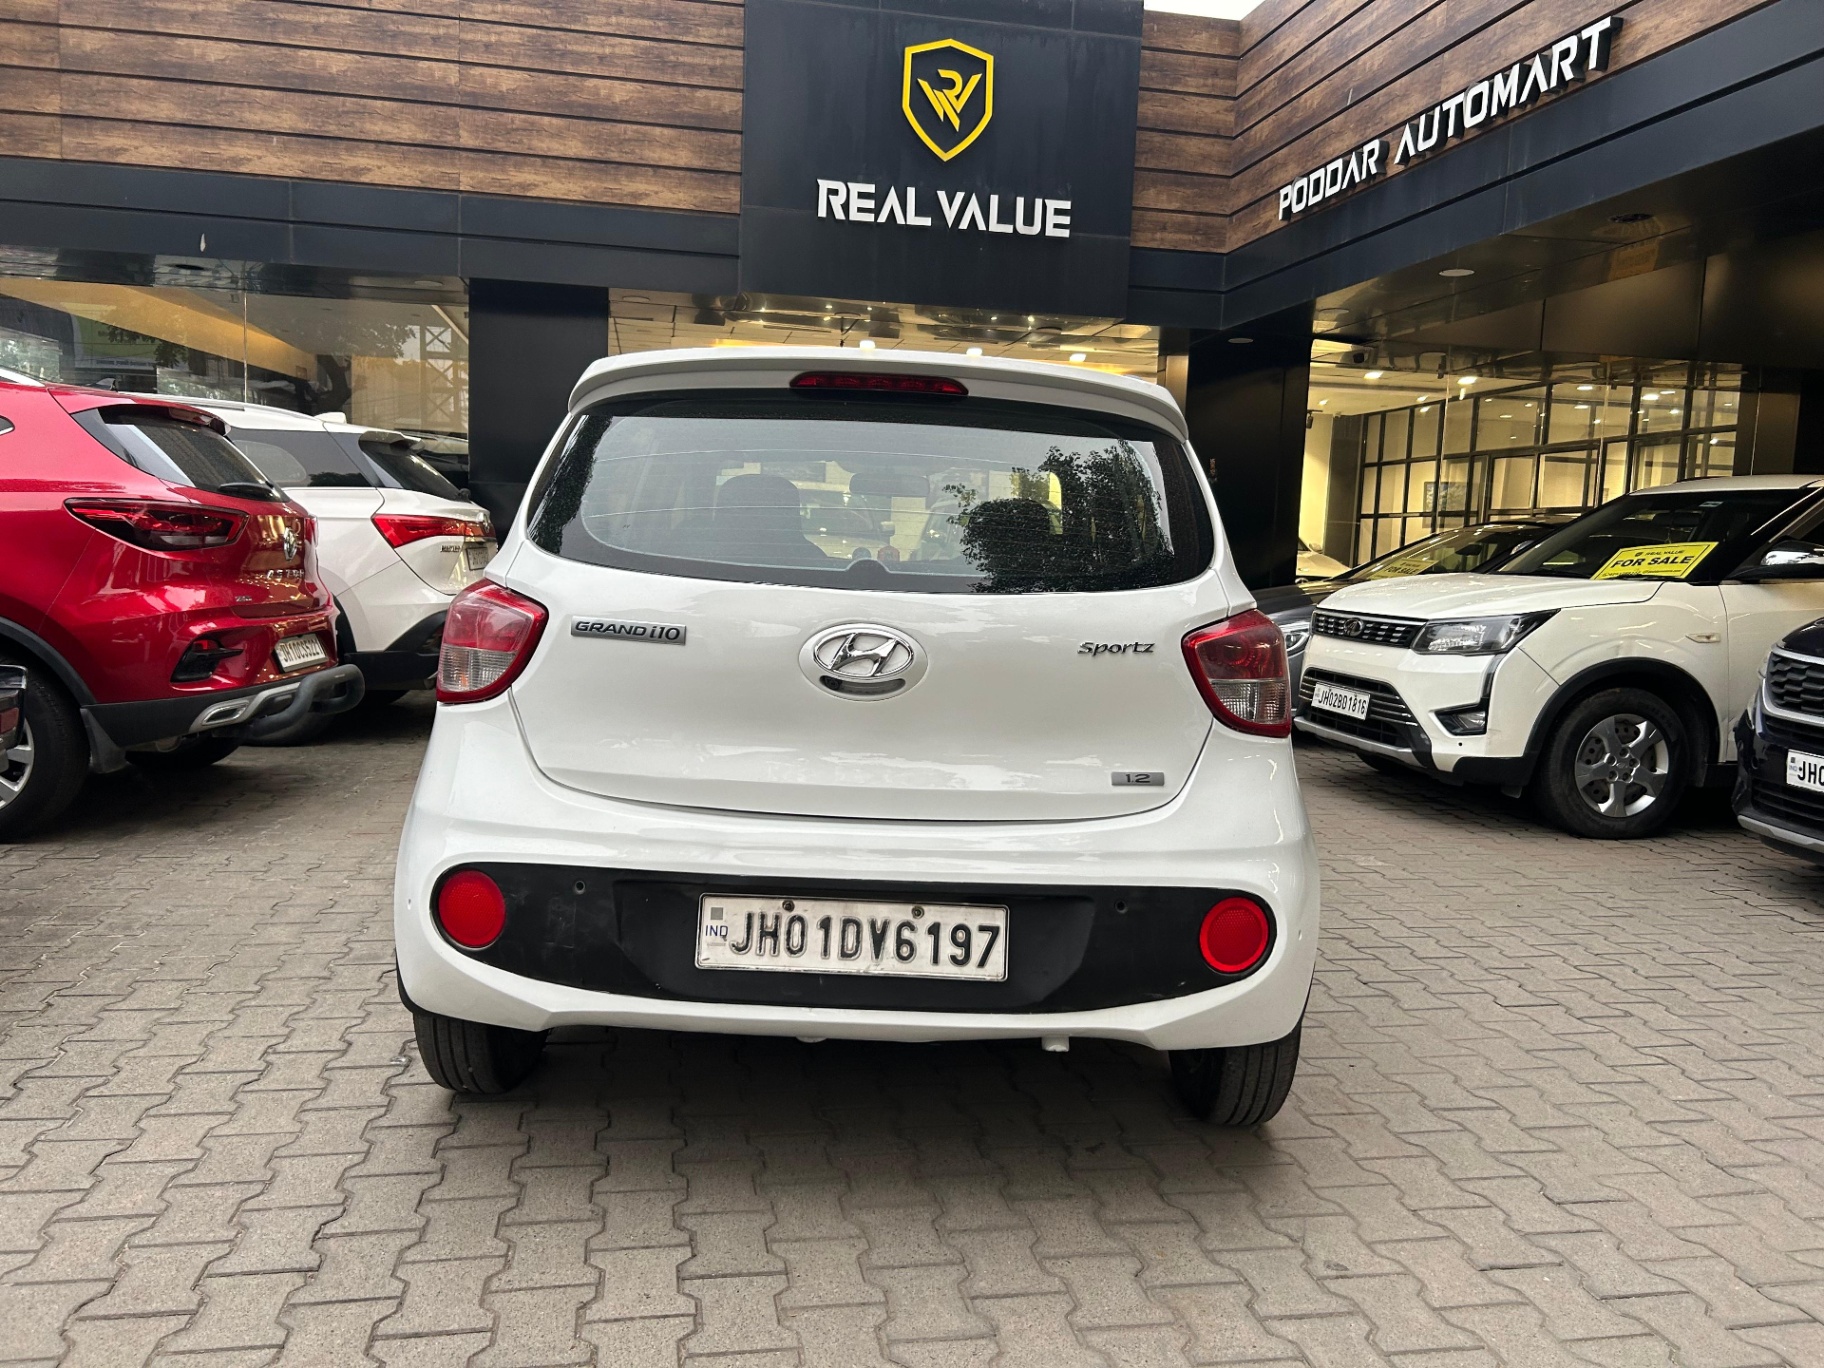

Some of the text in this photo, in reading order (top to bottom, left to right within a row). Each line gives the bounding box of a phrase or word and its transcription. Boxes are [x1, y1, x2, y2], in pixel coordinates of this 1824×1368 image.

[1278, 16, 1612, 221] PODDAR AUTOMART
[817, 179, 1072, 238] REAL VALUE
[1610, 555, 1695, 568] FOR SALE
[575, 621, 680, 640] GRAND i10
[1077, 641, 1155, 656] Sportz
[1318, 689, 1367, 715] JH02BD1816
[704, 924, 729, 938] IND
[730, 911, 1001, 968] JH01DV6197
